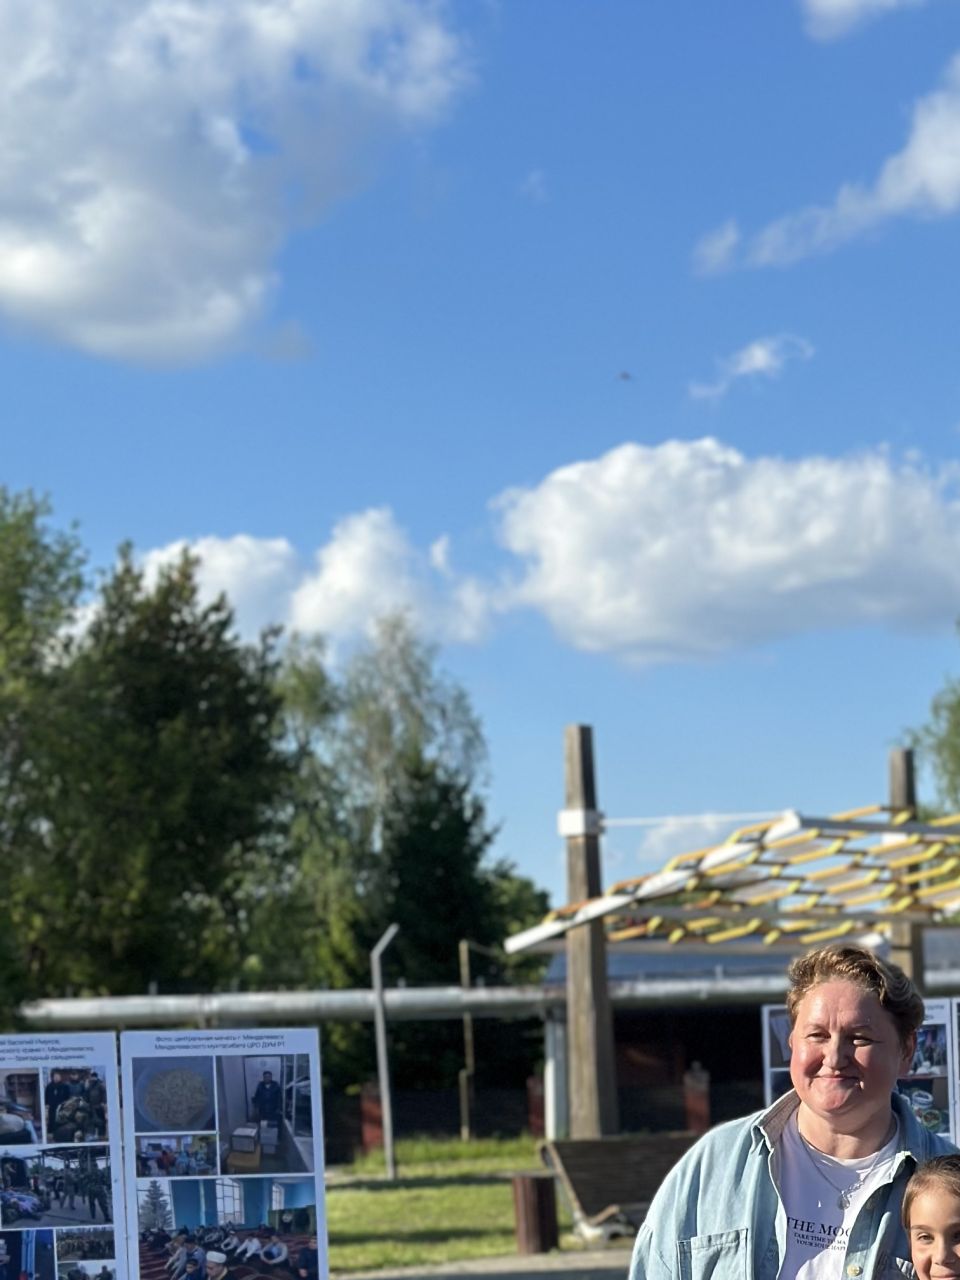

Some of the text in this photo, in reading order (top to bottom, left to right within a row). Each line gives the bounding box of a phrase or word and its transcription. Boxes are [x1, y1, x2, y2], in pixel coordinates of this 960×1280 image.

[787, 1217, 815, 1233] THE
[794, 1232, 810, 1240] TAKE
[811, 1235, 826, 1243] TIME
